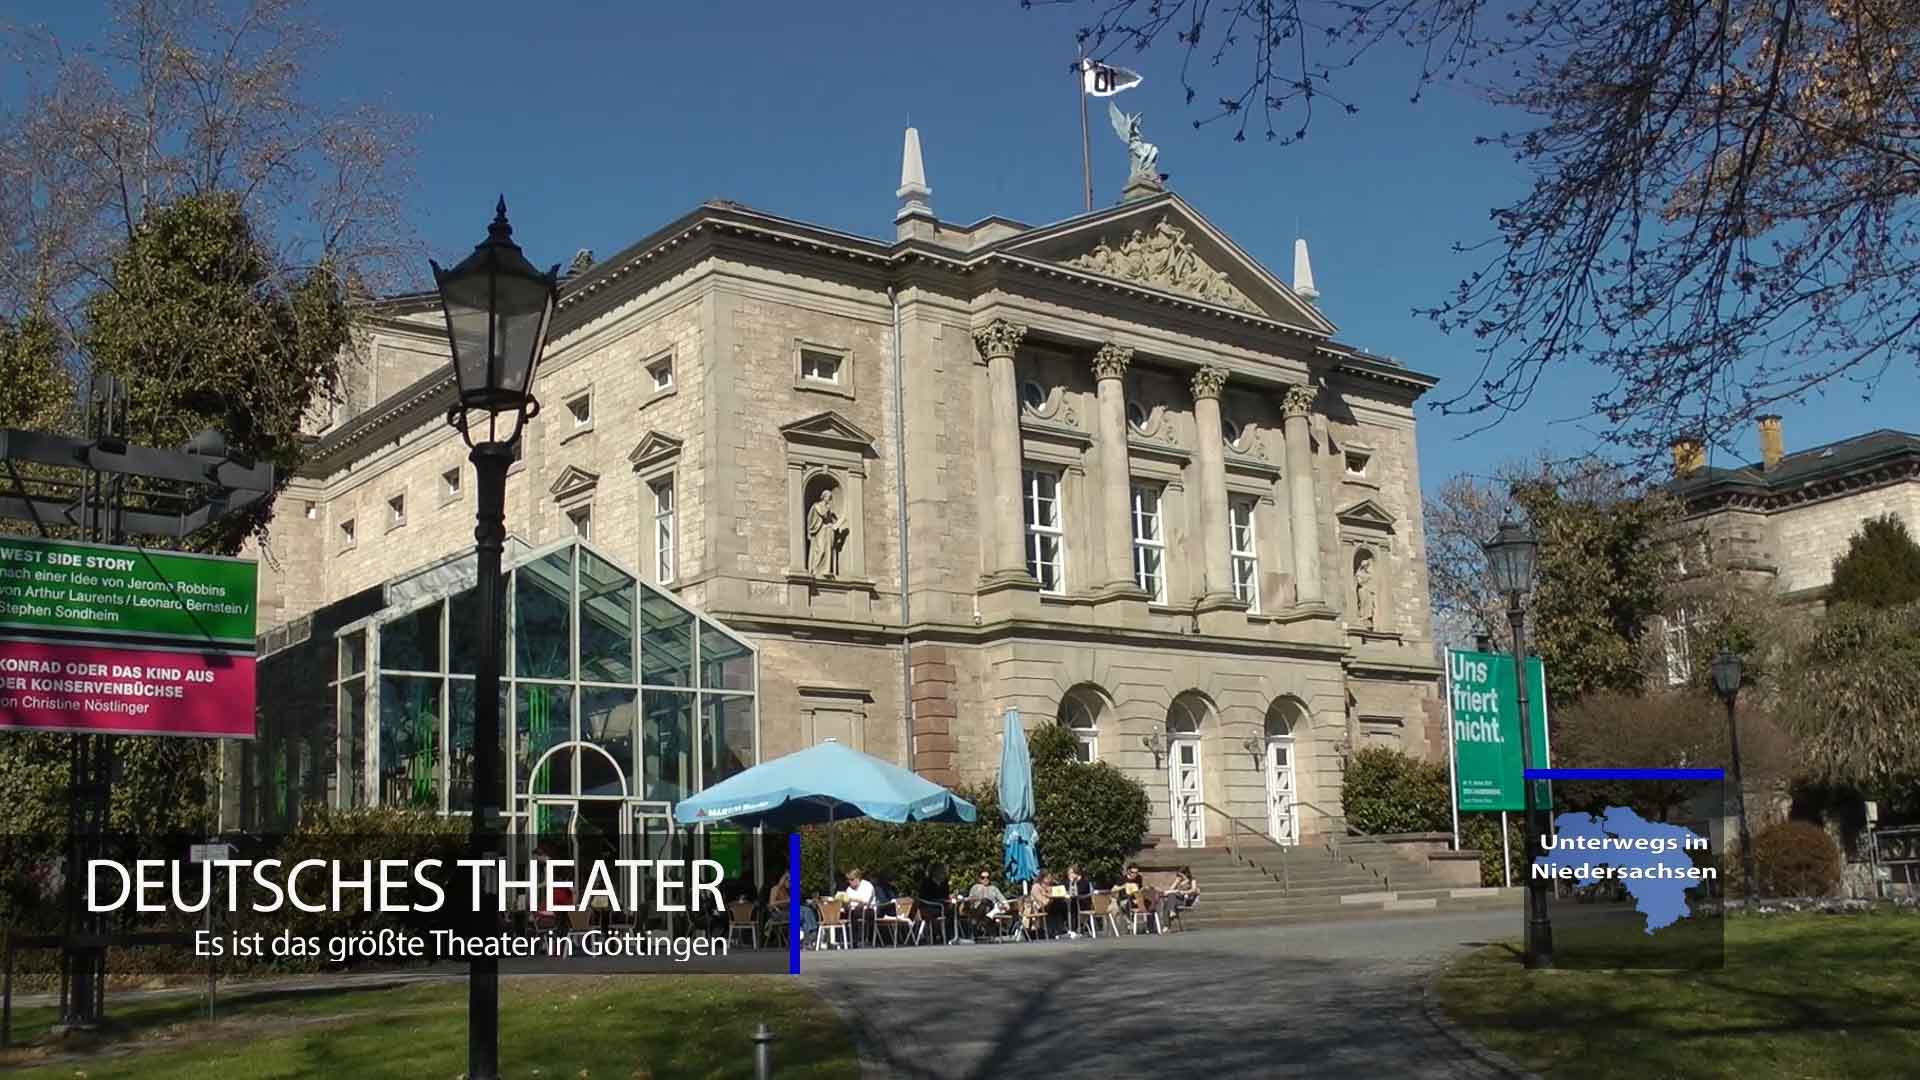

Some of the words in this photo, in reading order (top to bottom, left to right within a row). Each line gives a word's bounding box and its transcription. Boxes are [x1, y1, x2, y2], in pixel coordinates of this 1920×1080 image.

[0, 547, 42, 563] WEST
[47, 552, 82, 567] SIDE
[86, 555, 135, 571] STORY
[0, 567, 31, 579] nach
[34, 569, 67, 582] einer
[70, 571, 98, 585] Idee
[102, 576, 124, 588] von
[128, 578, 174, 592] Jerome
[176, 581, 226, 597] Robbins
[0, 601, 51, 617] Stephen
[54, 605, 119, 621] Sondheim
[25, 585, 65, 599] Arthur
[186, 599, 242, 614] Bernstein
[66, 663, 108, 676] ODER
[112, 665, 142, 679] DAS
[146, 667, 181, 681] KIND
[185, 669, 215, 682] AUS
[1451, 653, 1488, 683] Uns
[31, 678, 183, 698] KONSERVENBÜCHSE
[1454, 683, 1499, 712] friert
[0, 697, 17, 708] on
[22, 695, 80, 711] Christine
[84, 698, 150, 716] Nöstlinger
[1455, 713, 1504, 743] nicht.
